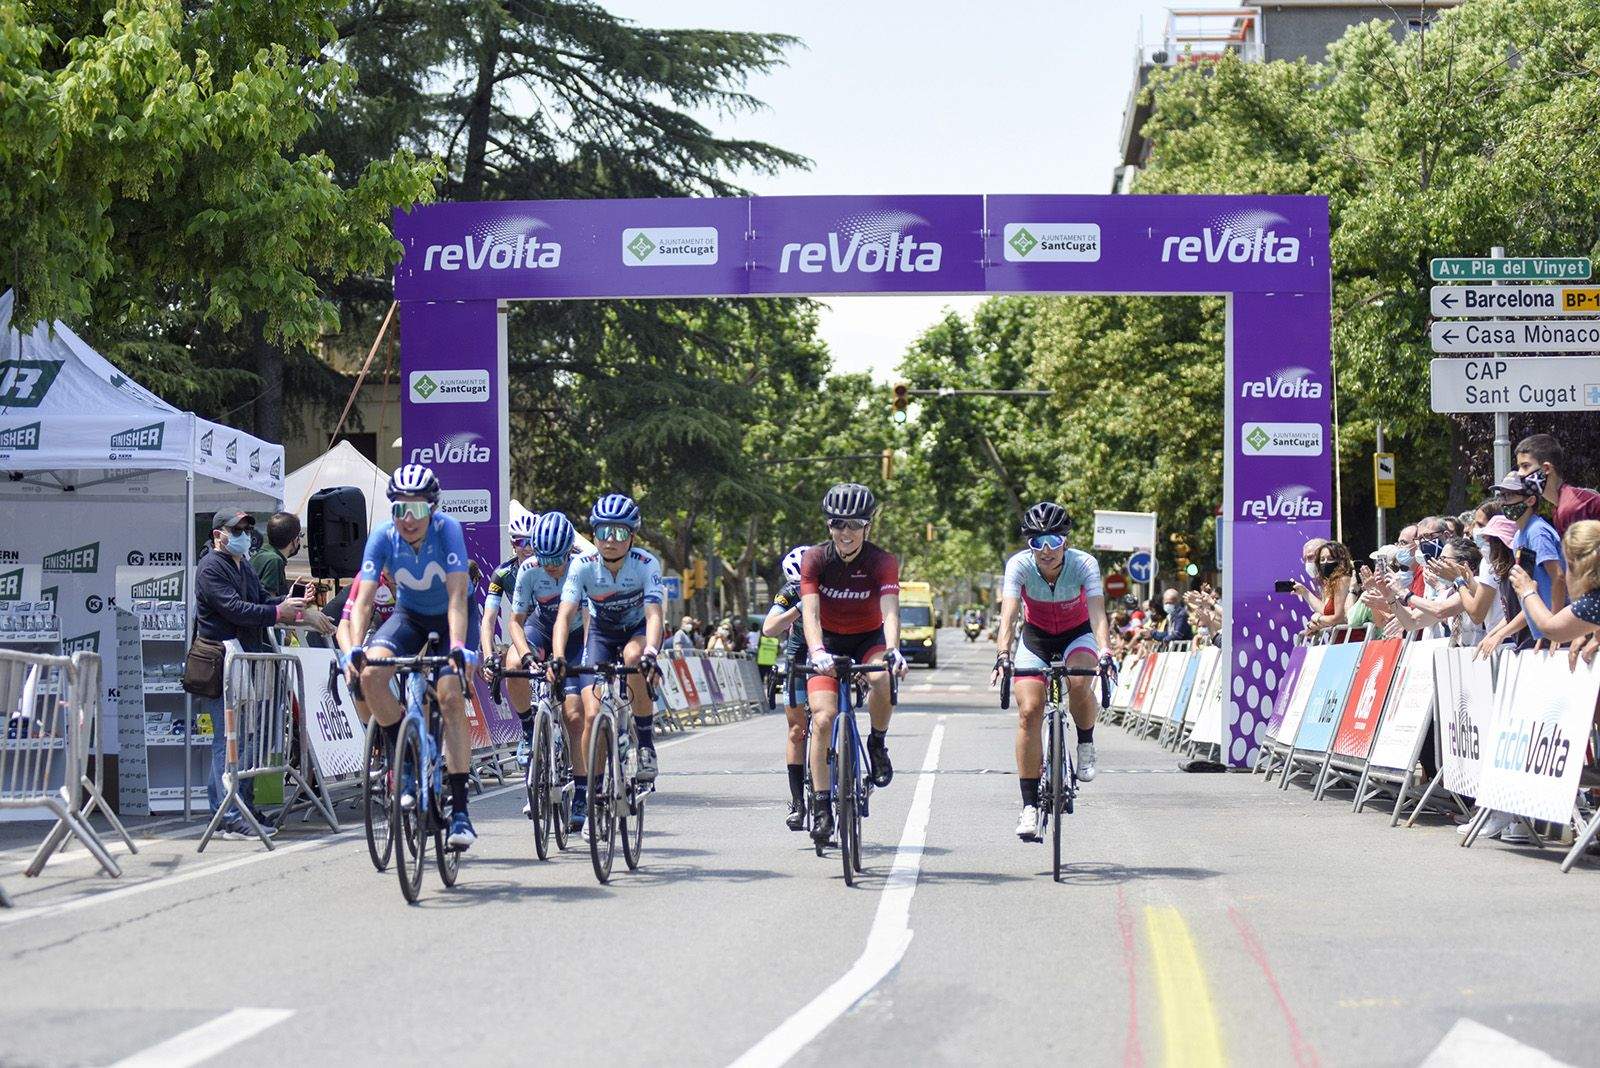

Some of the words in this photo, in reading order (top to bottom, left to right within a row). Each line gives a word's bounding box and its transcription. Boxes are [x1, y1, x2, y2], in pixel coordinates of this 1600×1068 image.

[659, 238, 702, 246] AJUNTAMENT
[659, 244, 715, 256] SantCugat
[1041, 241, 1097, 253] SantCugat
[1161, 227, 1301, 265] reVolta
[423, 234, 562, 271] reVolta
[779, 232, 942, 274] reVolta
[1439, 261, 1465, 275] Av.
[1472, 261, 1495, 275] Pla
[1503, 261, 1526, 275] del
[1533, 260, 1584, 277] Vinyet
[1465, 290, 1555, 308] Barcelona
[1466, 325, 1516, 344] Casa
[1524, 325, 1600, 343] Mònaco
[1465, 361, 1507, 380] CAP
[440, 385, 487, 394] SantCugat
[1241, 377, 1323, 399] reVolta
[1466, 385, 1510, 404] Sant
[1519, 384, 1577, 407] Cugat
[112, 428, 159, 447] FINISHER
[1273, 438, 1319, 448] SantCugat
[410, 443, 491, 464] reVolta
[441, 505, 488, 513] SantCugat
[1242, 495, 1323, 517] reVolta
[1097, 526, 1113, 534] 25
[44, 549, 94, 569] FINISHER
[149, 552, 182, 561] KERN
[133, 577, 179, 597] FINISHER
[316, 700, 353, 742] reVolta
[1449, 710, 1480, 760] reVolta
[1495, 719, 1570, 778] cicloVolta
